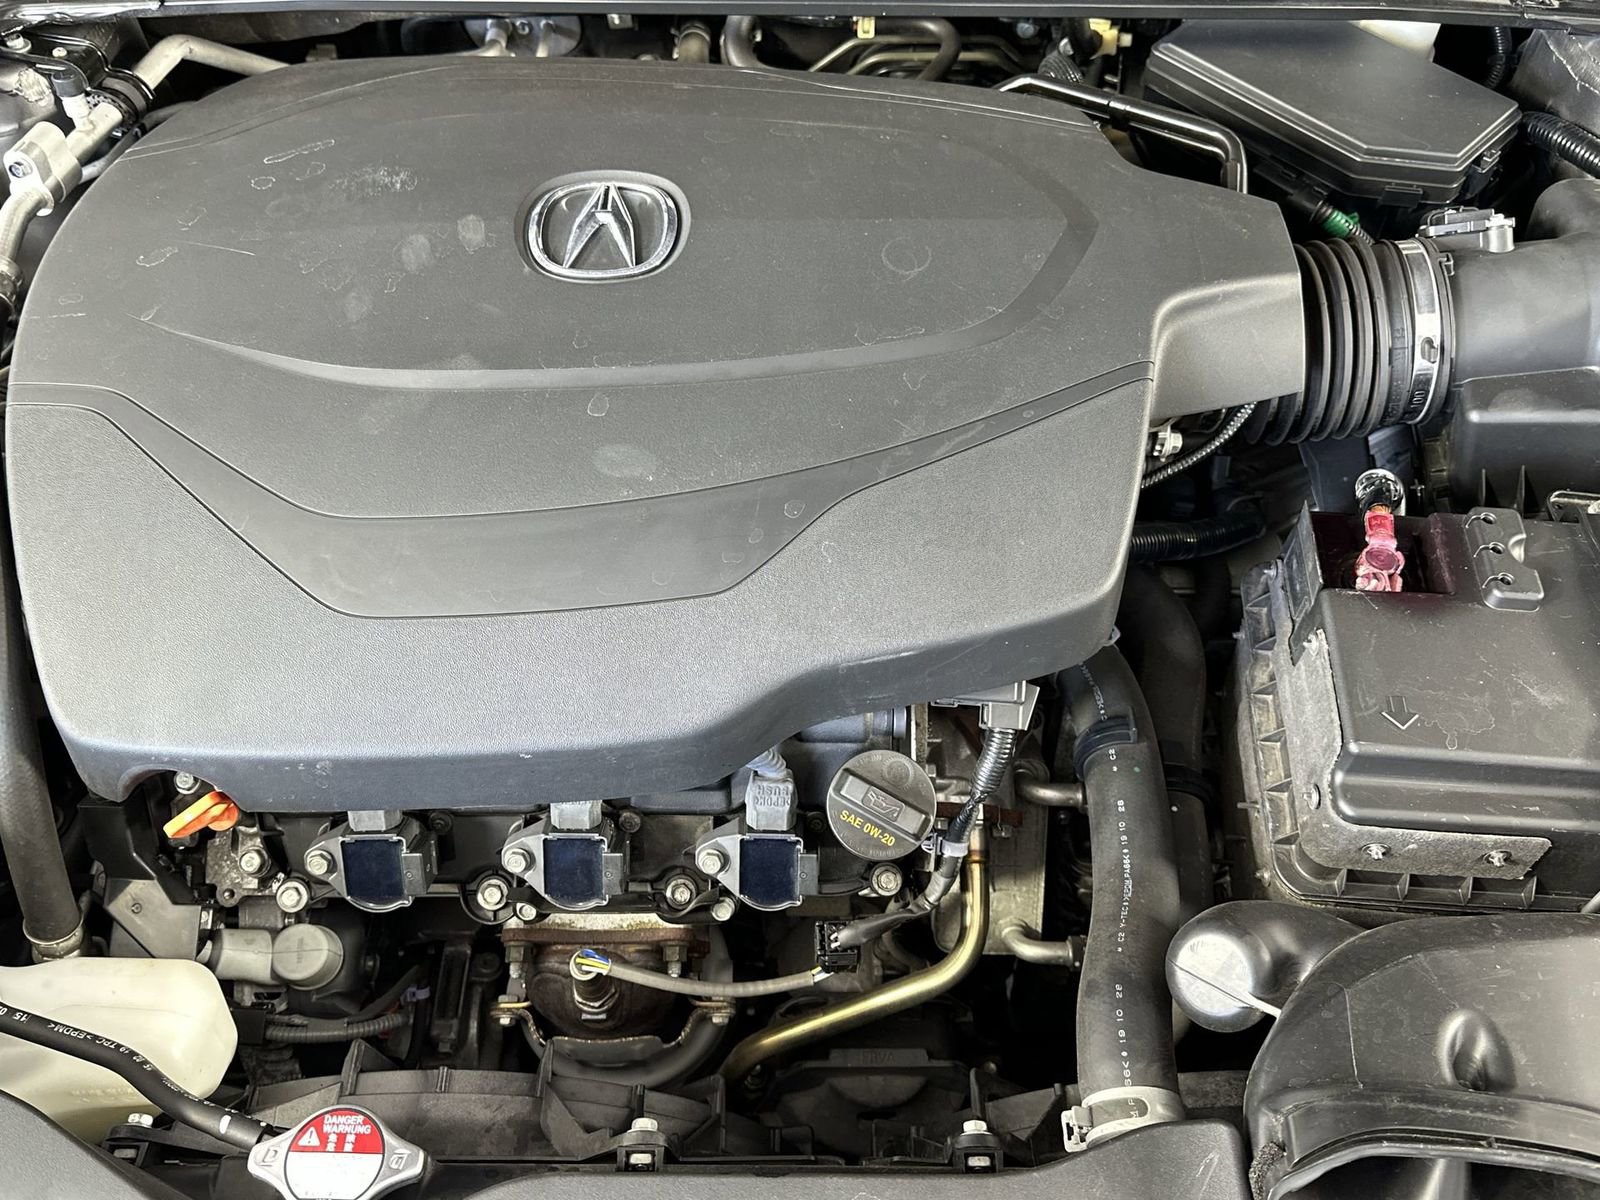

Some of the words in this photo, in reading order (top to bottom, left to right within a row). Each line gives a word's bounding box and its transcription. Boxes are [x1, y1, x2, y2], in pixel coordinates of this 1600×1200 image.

[839, 809, 864, 829] SAE
[863, 822, 896, 847] 0W-20
[95, 1036, 118, 1050] TPC
[323, 1114, 365, 1125] DANGER
[322, 1124, 371, 1134] WARNUNG
